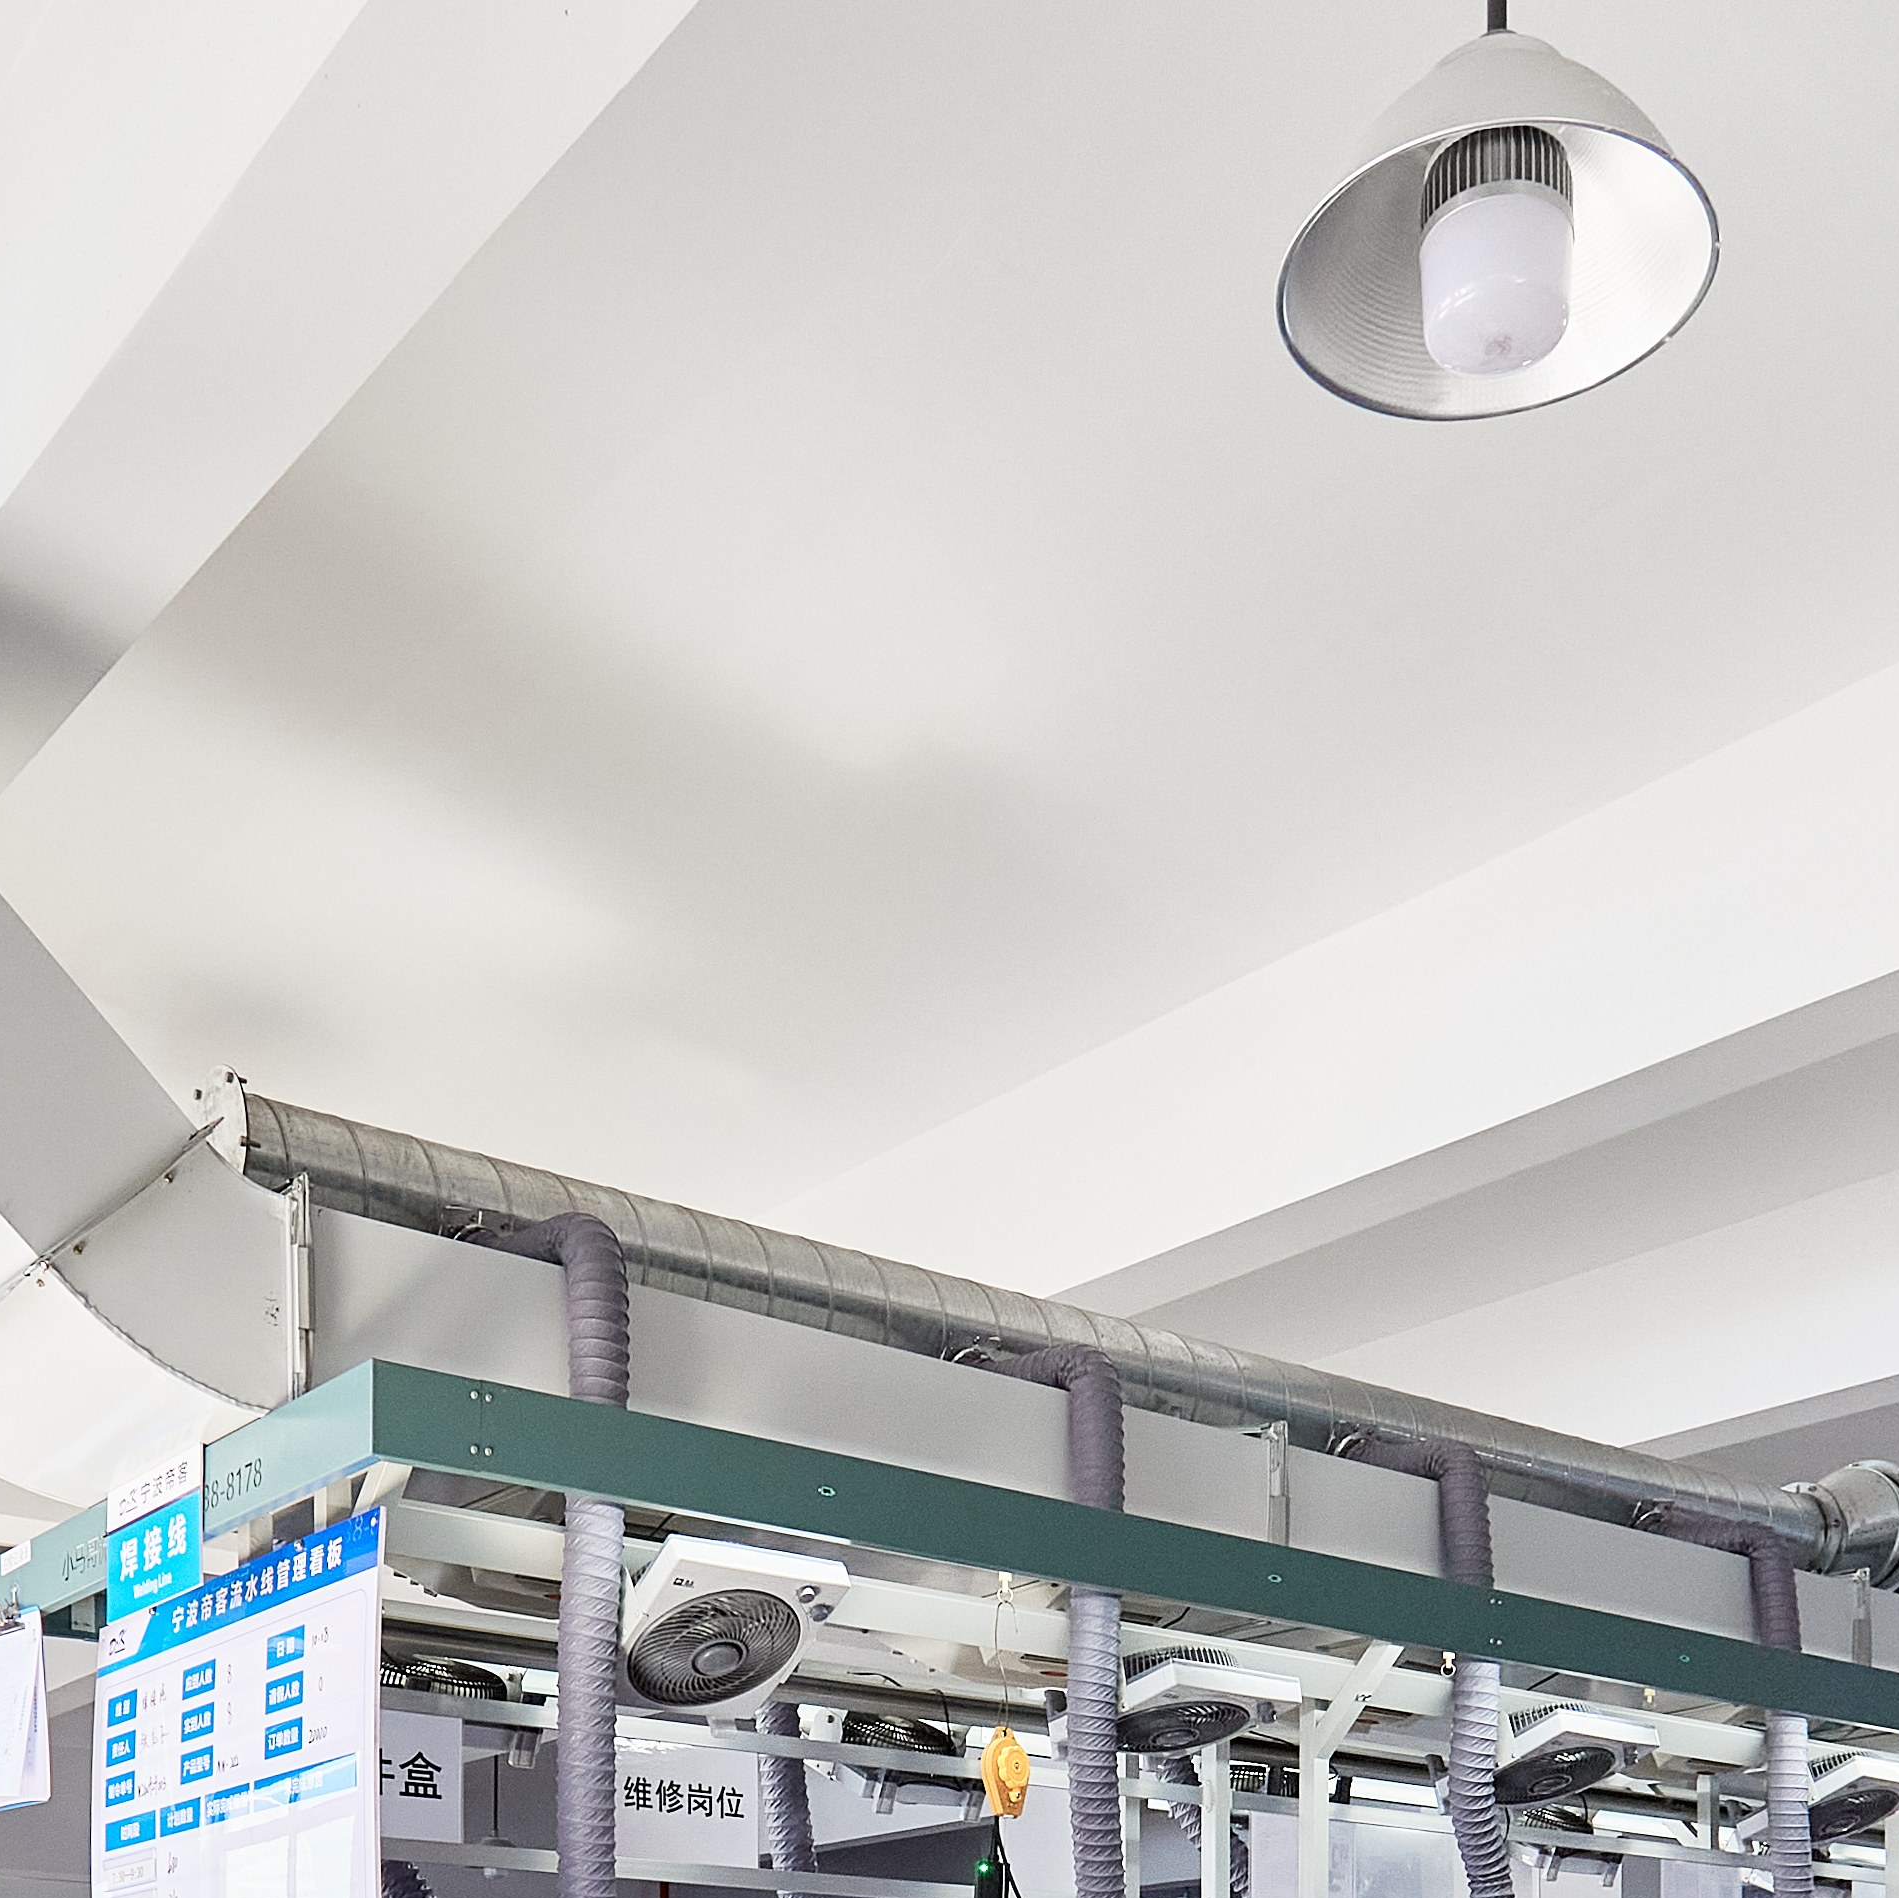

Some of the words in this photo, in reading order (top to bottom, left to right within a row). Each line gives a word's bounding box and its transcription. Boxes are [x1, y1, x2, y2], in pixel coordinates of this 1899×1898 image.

[140, 1461, 188, 1504] 宁波帝客
[119, 1513, 187, 1582] 焊接线
[157, 1572, 172, 1591] Line
[172, 1536, 343, 1633] 宁波帝客流水线管理看板
[623, 1777, 745, 1819] 维修岗位
